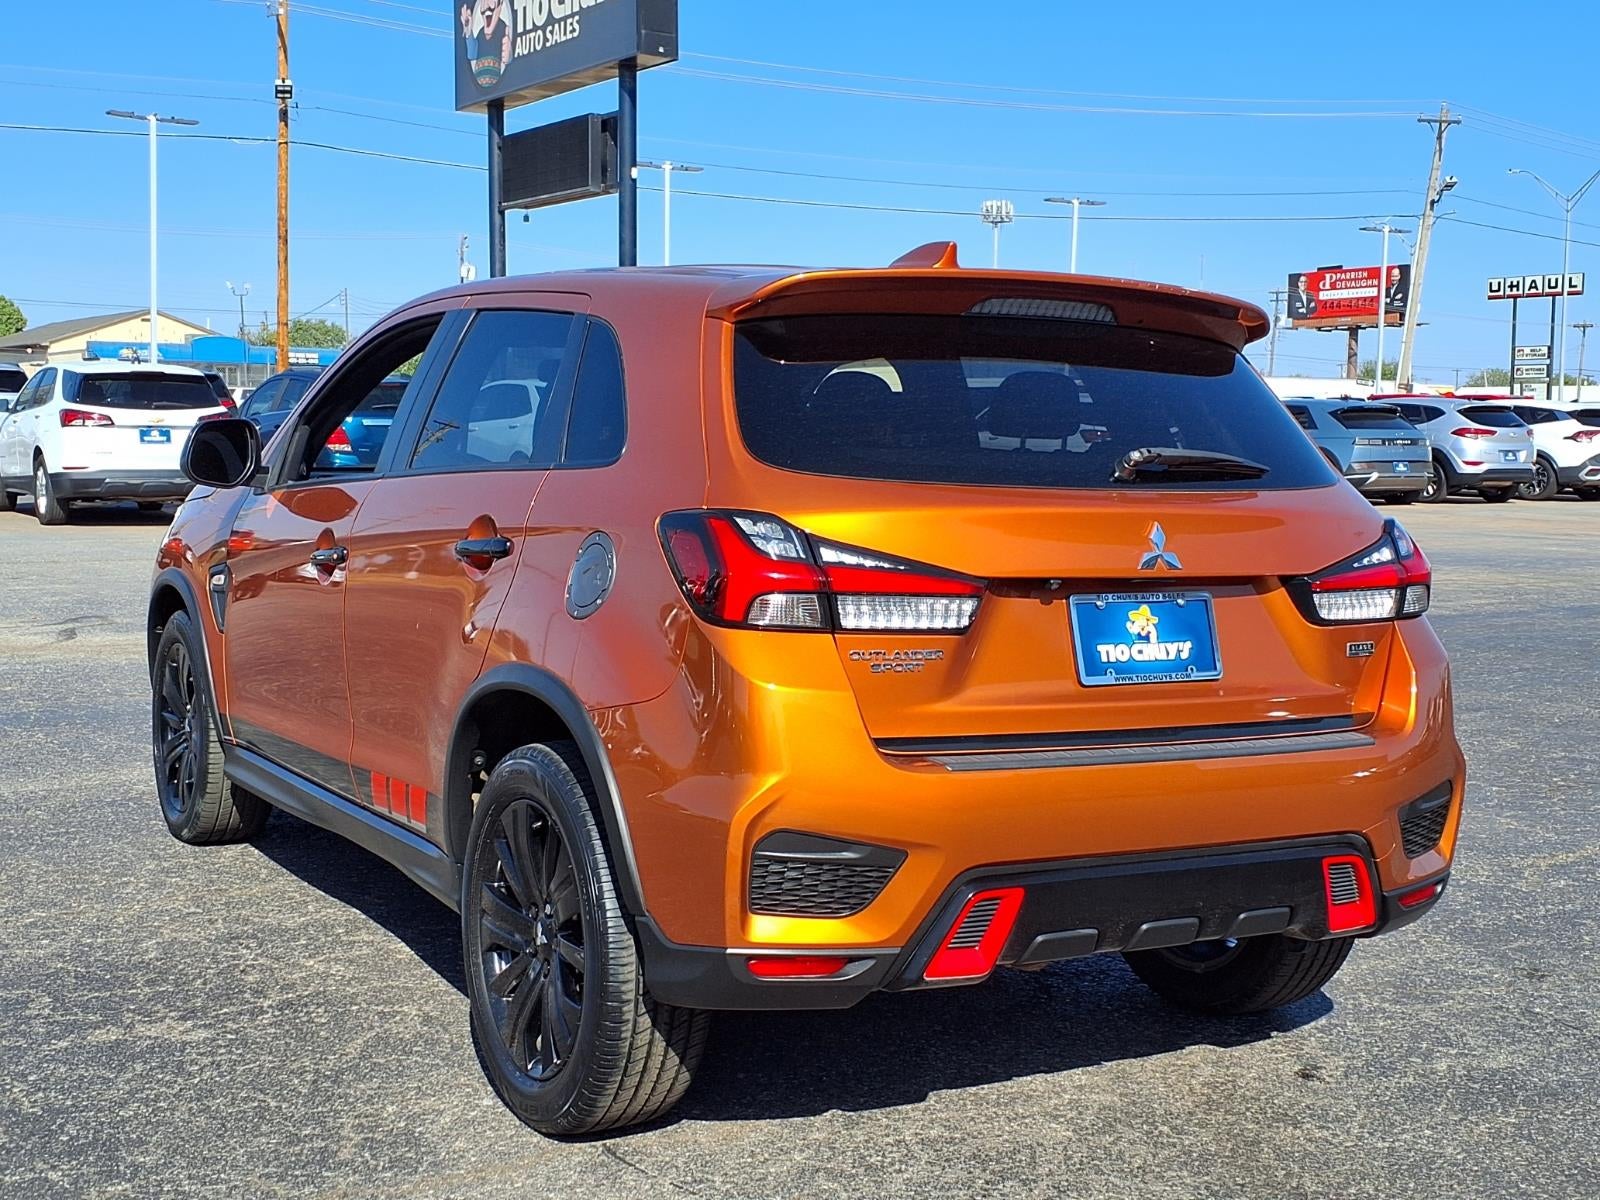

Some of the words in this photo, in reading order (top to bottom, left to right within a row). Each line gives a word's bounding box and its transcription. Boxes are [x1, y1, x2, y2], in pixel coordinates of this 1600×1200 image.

[514, 30, 542, 58] AUTO
[545, 15, 580, 47] SALES
[1336, 271, 1368, 279] PARRISH
[1336, 279, 1378, 288] DEVAUGHN
[1162, 592, 1185, 600] SALES
[849, 649, 944, 660] OUTLANDER
[870, 662, 924, 673] SPORT
[1114, 672, 1192, 683] WWW.TIOCHUYS.COM
